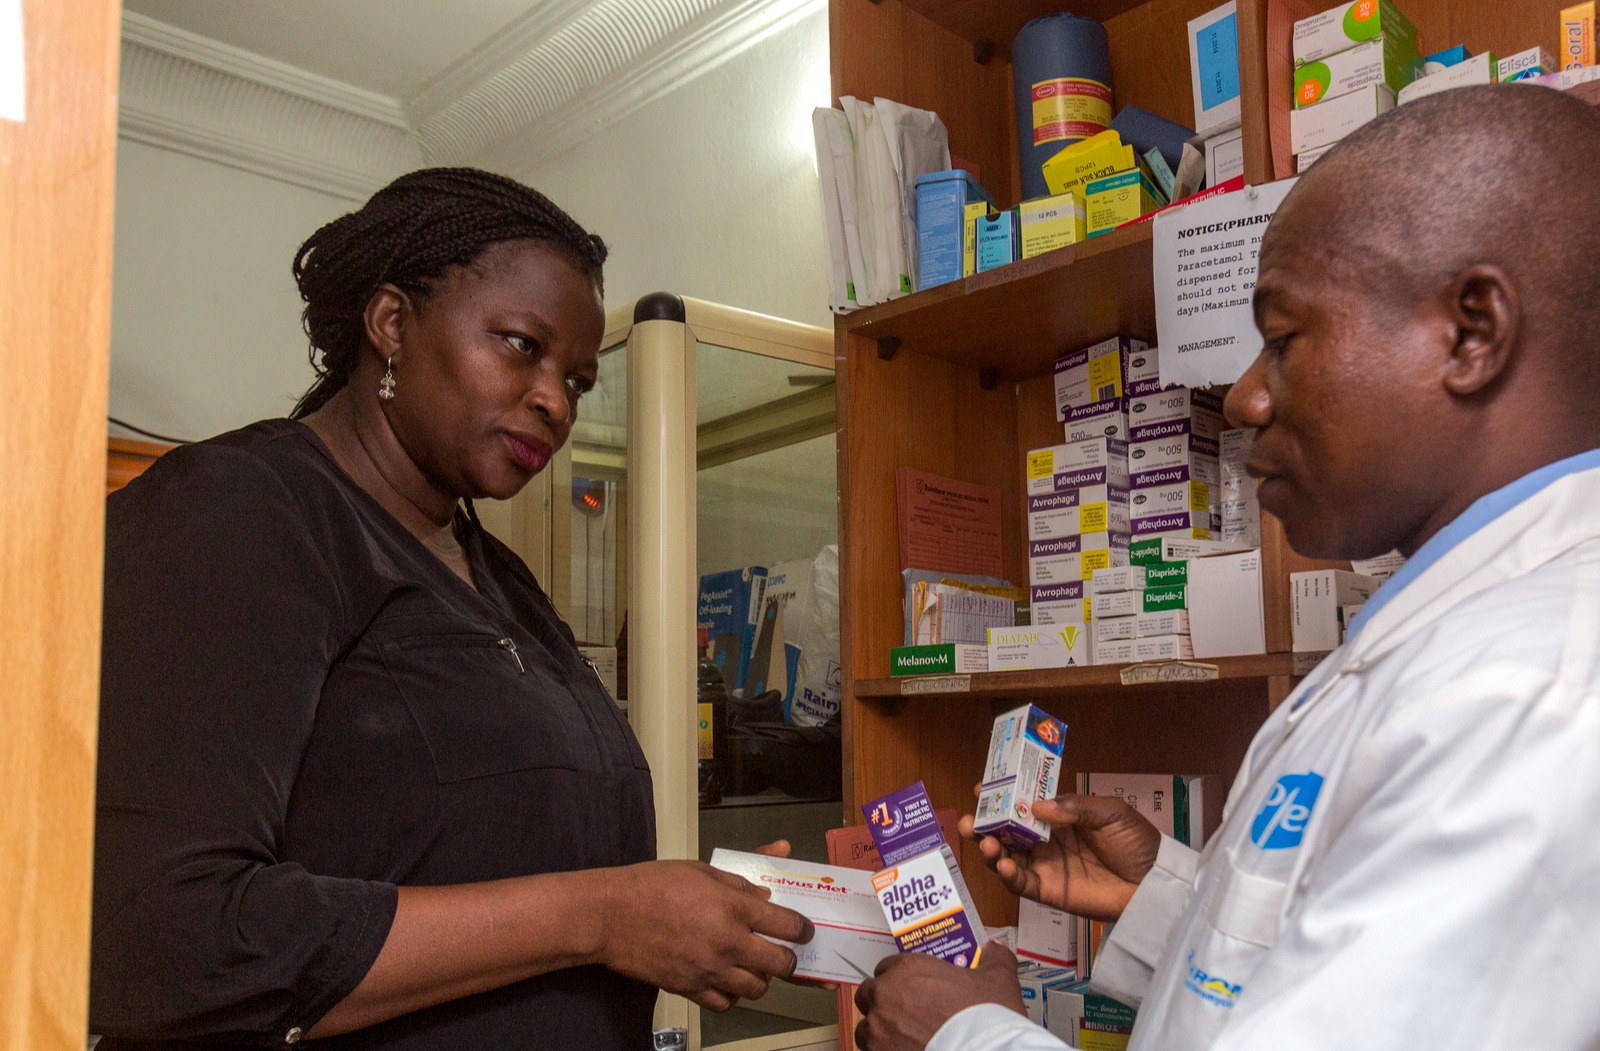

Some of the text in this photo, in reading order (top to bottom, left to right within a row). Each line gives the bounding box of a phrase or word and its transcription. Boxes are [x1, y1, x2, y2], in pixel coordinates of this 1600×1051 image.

[1360, 2, 1370, 12] 20
[1295, 14, 1328, 30] Omeprazole
[1348, 74, 1382, 89] Omeprazole
[1304, 90, 1315, 99] 20
[1075, 162, 1096, 173] 12PCS
[1094, 165, 1115, 178] BLACK
[1080, 172, 1094, 185] SILK
[1178, 213, 1274, 240] NOTICE(PHARM
[1178, 248, 1195, 259] The
[1200, 238, 1245, 254] maximum
[1178, 252, 1244, 273] Paracetamol
[1176, 266, 1256, 287] dispensed for
[1177, 281, 1256, 302] should not ex
[1176, 297, 1249, 316] days(Maximum
[1178, 336, 1240, 354] MANAGEMENT.
[1054, 352, 1086, 371] Avrophage
[1071, 400, 1114, 418] Avrophage
[1168, 398, 1184, 409] 500
[1071, 431, 1086, 440] 500
[1136, 423, 1184, 439] Avrophage
[1166, 444, 1182, 455] 500
[1057, 472, 1103, 487] Avrophage
[1136, 470, 1182, 485] Avrophage
[1032, 494, 1075, 507] Avrophage
[1167, 491, 1183, 502] 500
[1137, 517, 1184, 532] Avrophage
[1034, 541, 1076, 552] Avrophage
[1131, 546, 1160, 559] Diapride-2
[1148, 567, 1185, 579] Diapride-2
[1036, 587, 1079, 598] Avrophage
[1146, 591, 1183, 603] Diapride-2
[898, 653, 948, 668] Melanov-M
[804, 687, 838, 711] Rain
[871, 801, 893, 827] #1
[904, 805, 930, 820] DIABETIC
[905, 801, 920, 812] FIRST
[903, 812, 933, 829] NUTRITION
[760, 875, 848, 894] Galvus Met
[883, 874, 936, 906] alpha
[900, 917, 955, 945] Multi-Vitamin
[945, 942, 972, 957] Protection
